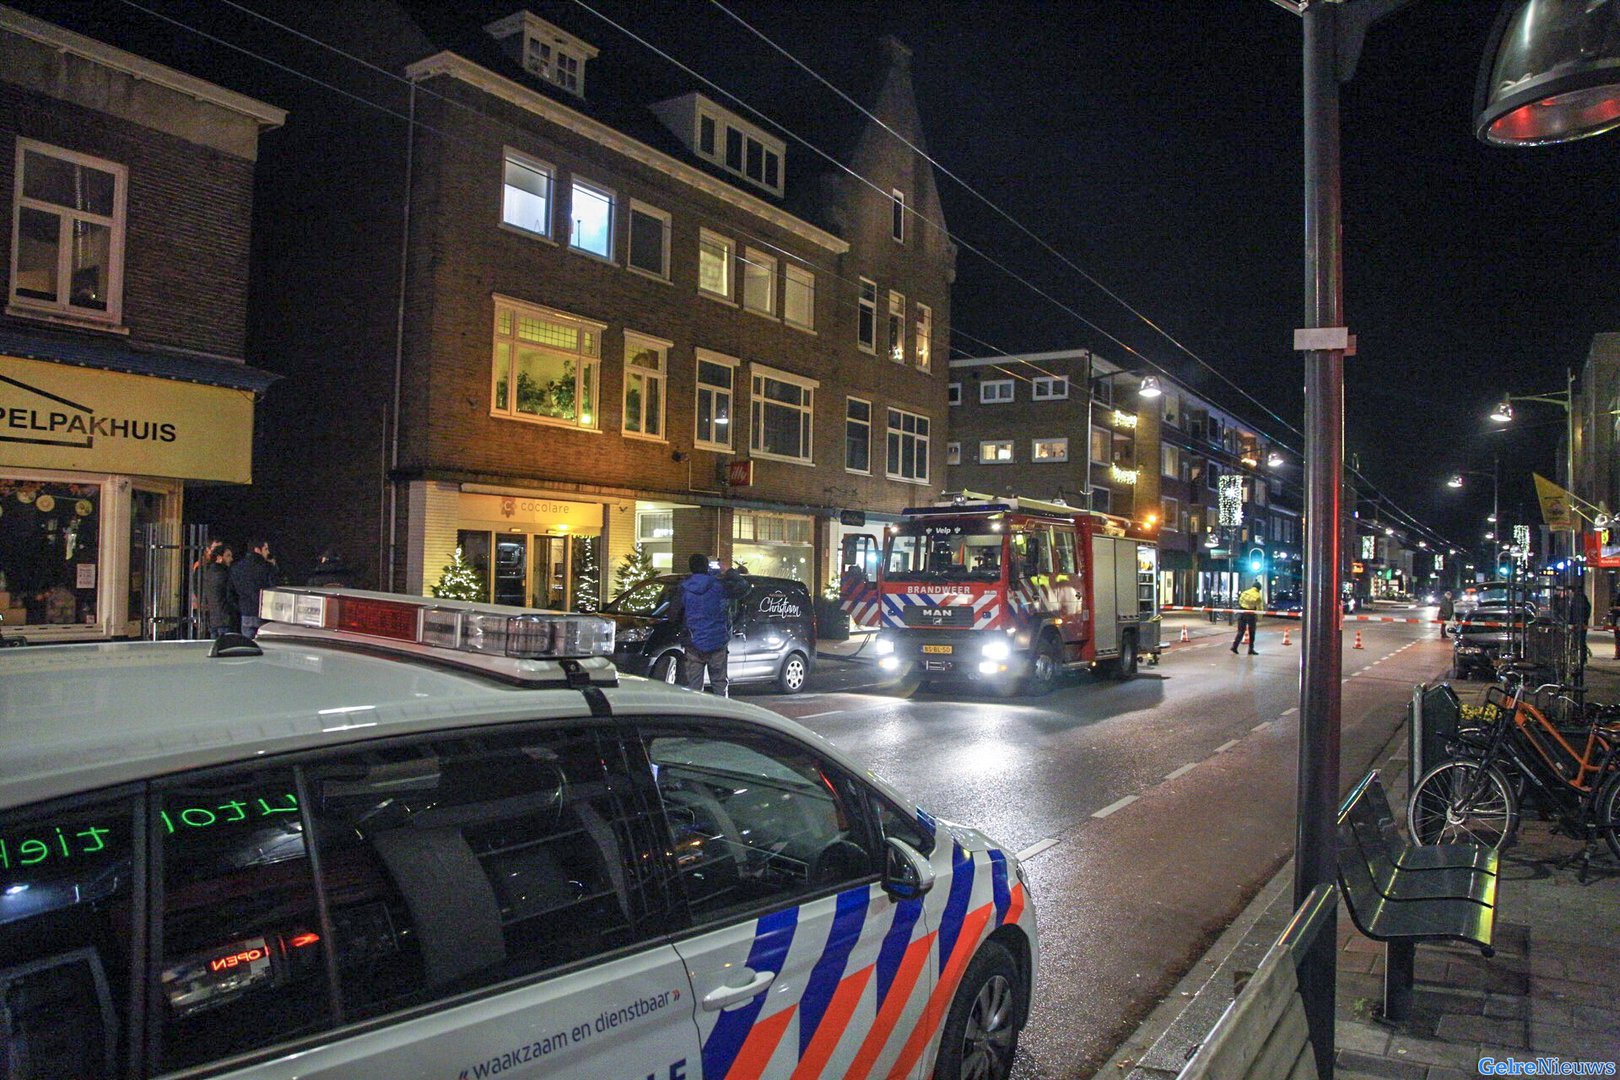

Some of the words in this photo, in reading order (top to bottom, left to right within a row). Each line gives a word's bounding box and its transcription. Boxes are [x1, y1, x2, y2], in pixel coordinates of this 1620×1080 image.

[521, 502, 570, 513] cocolare
[907, 585, 971, 595] BRANDWEER
[922, 609, 952, 617] MAN
[472, 1031, 568, 1080] waakzaam
[571, 1022, 591, 1042] en
[595, 991, 670, 1034] dienstbaar
